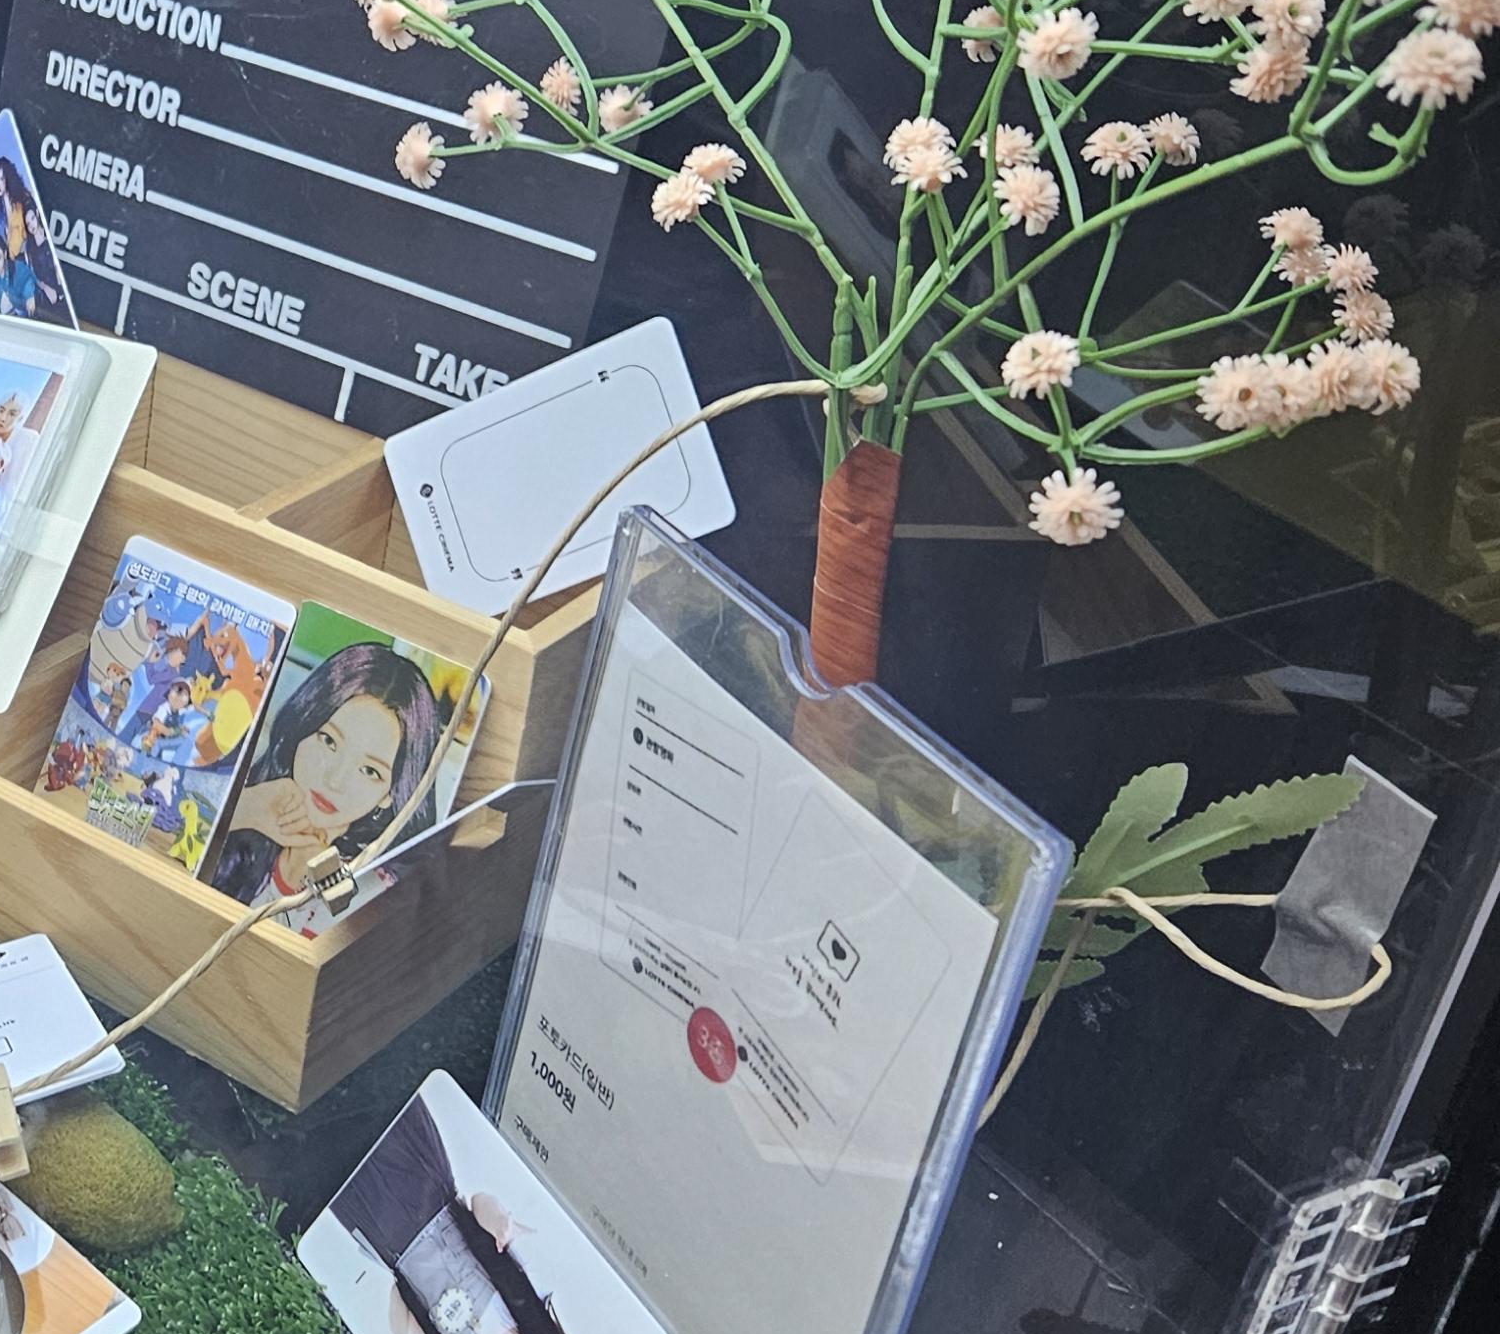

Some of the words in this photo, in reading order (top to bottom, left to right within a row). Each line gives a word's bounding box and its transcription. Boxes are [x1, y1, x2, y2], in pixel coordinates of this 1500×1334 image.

[45, 52, 182, 128] DIRECTOR
[40, 134, 146, 202] CAMERA
[50, 209, 128, 270] DATE
[187, 262, 305, 336] SCENE
[427, 500, 442, 532] LOTTE
[530, 1050, 578, 1115] 1,000원
[537, 1013, 616, 1112] 포토카드(일반)
[513, 1114, 550, 1164] 구매제한
